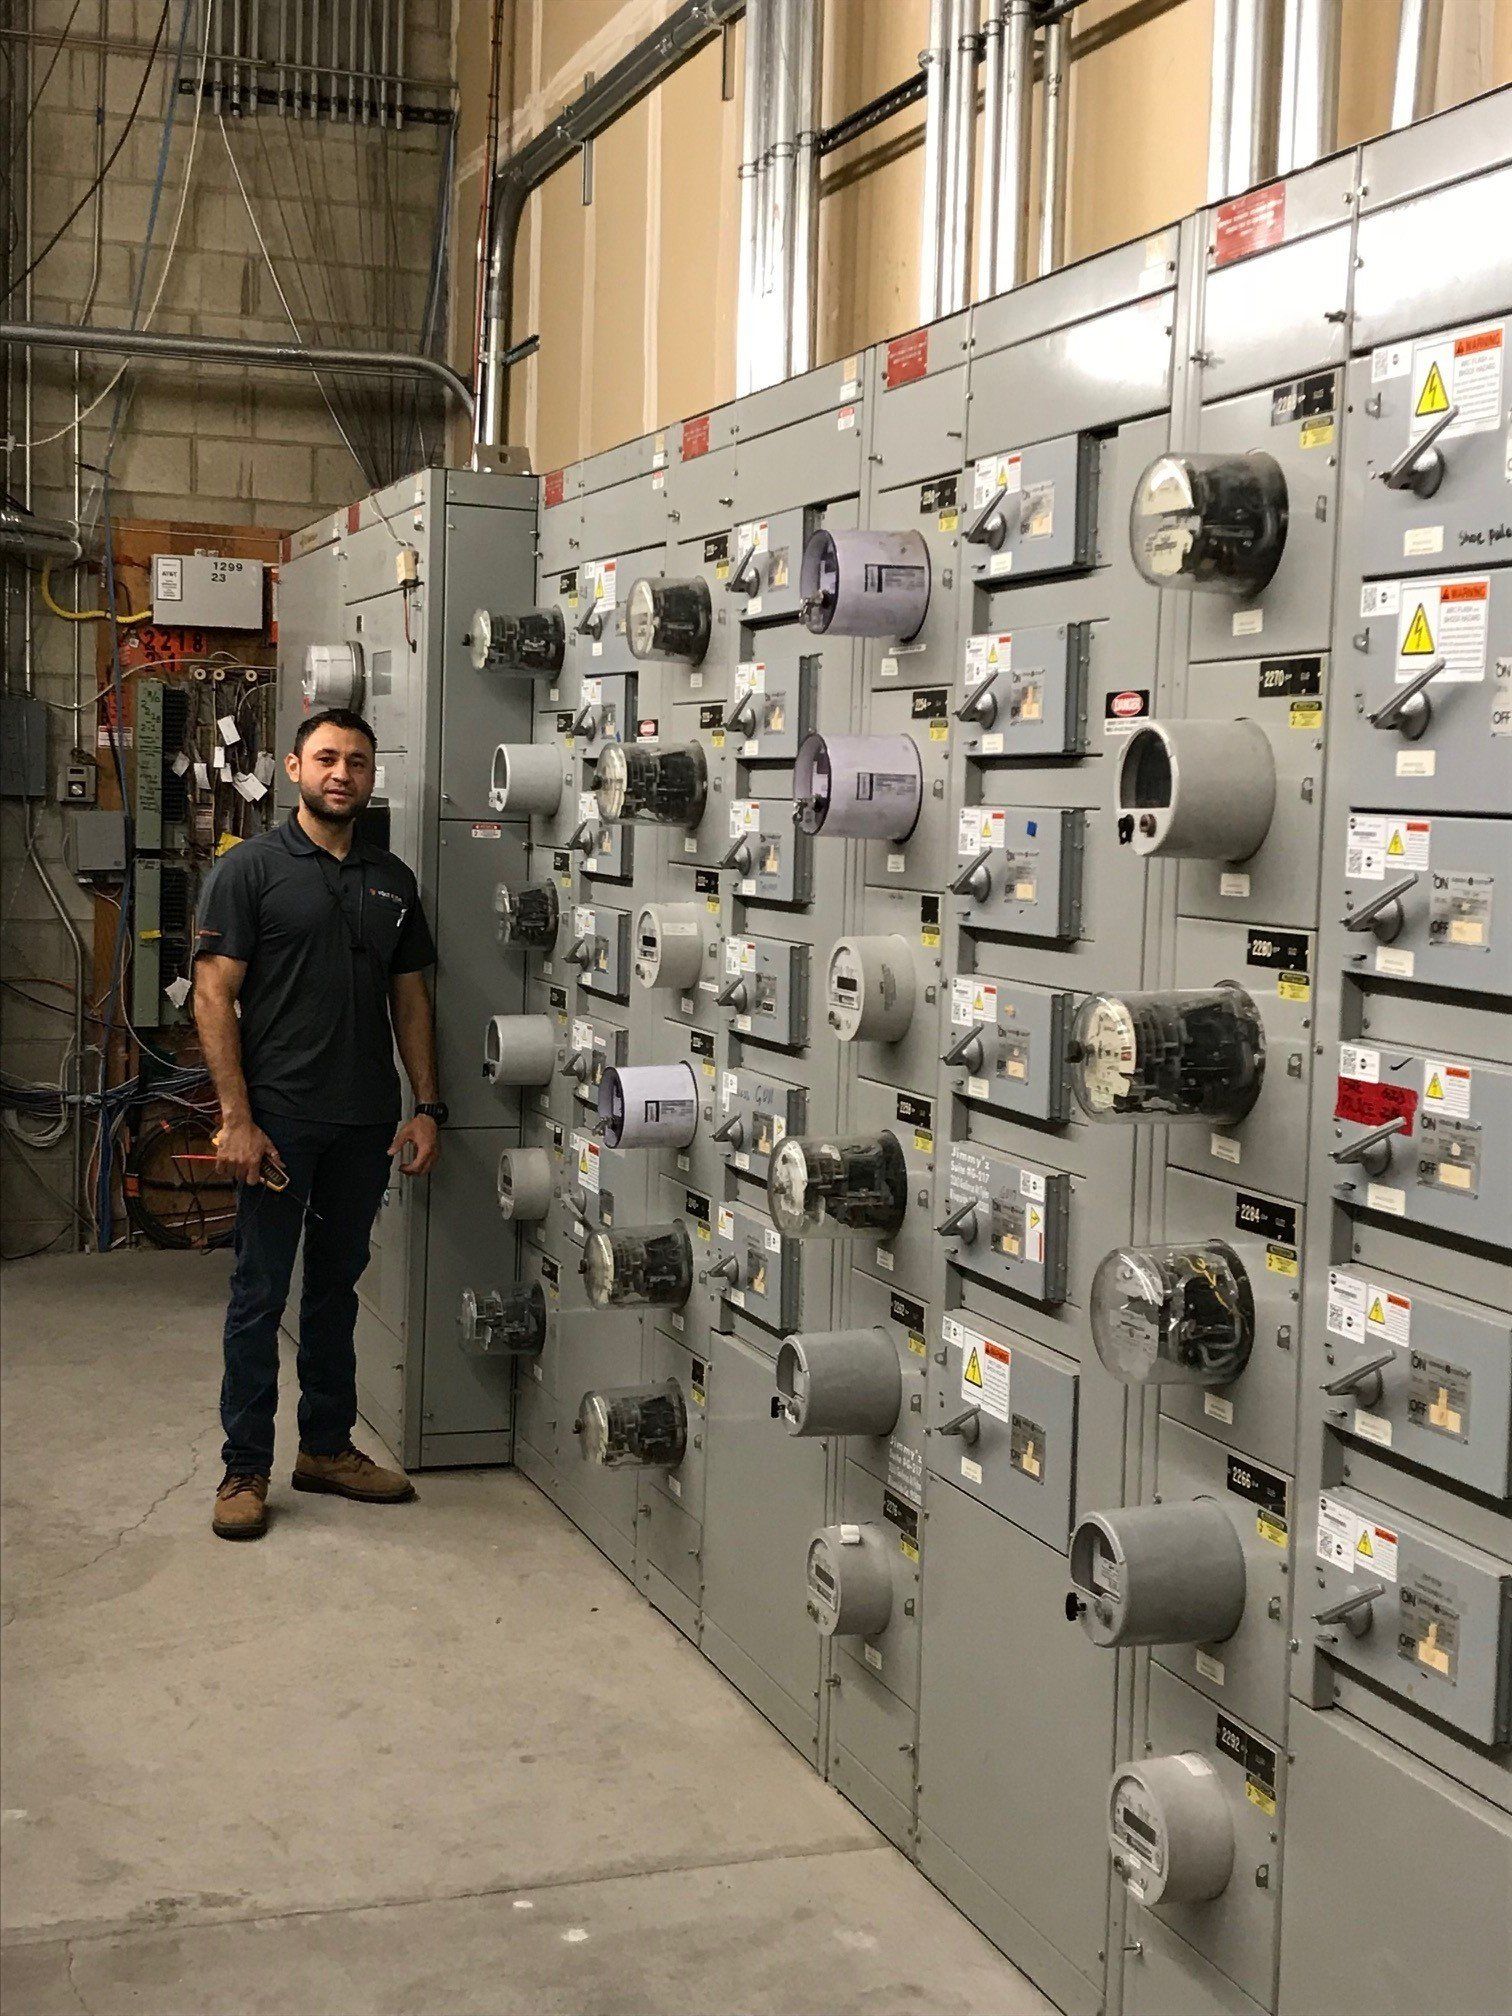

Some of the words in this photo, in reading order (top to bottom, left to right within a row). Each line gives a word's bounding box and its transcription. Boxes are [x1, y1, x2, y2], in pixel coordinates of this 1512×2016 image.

[213, 561, 243, 572] 1299
[211, 573, 226, 583] 23
[1493, 711, 1511, 725] OFF
